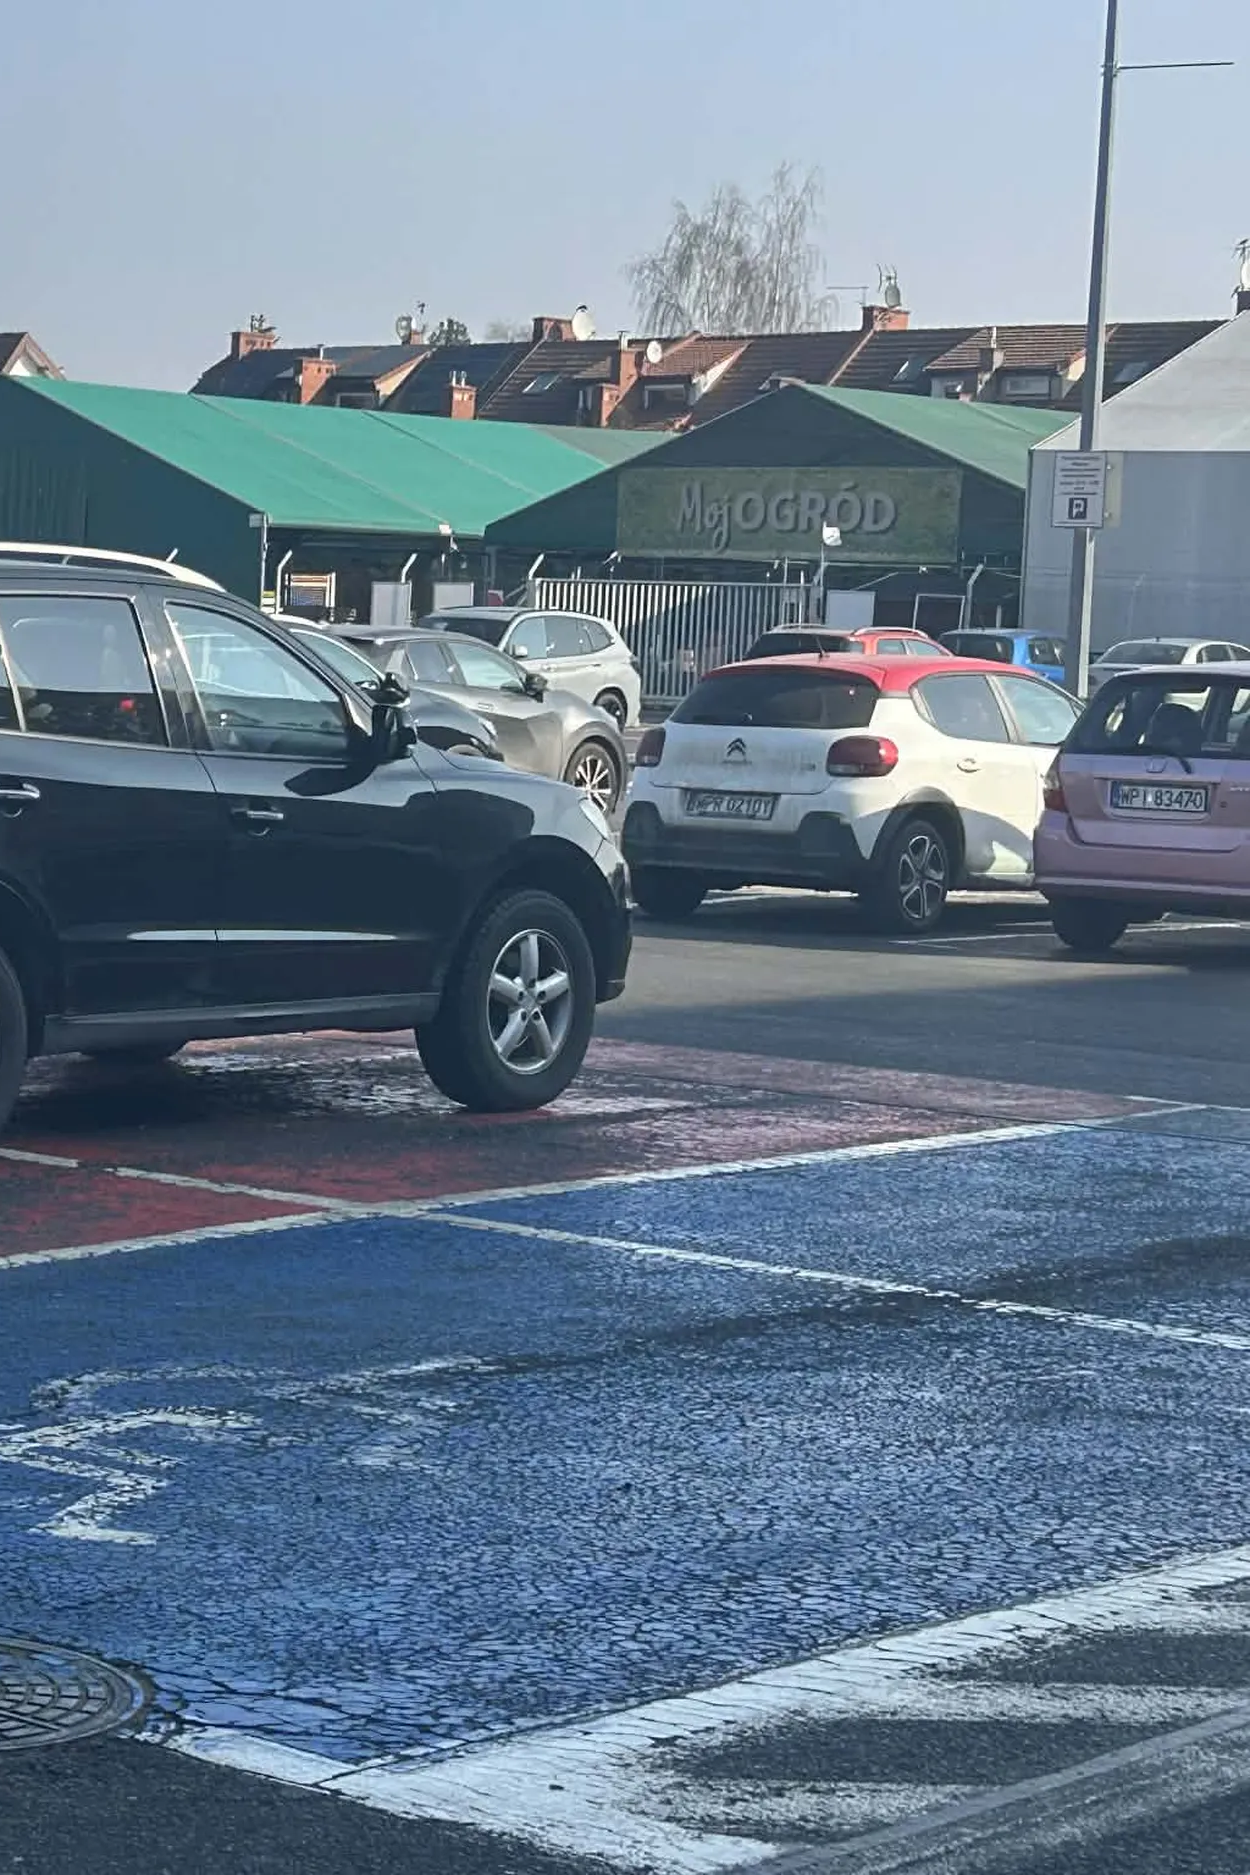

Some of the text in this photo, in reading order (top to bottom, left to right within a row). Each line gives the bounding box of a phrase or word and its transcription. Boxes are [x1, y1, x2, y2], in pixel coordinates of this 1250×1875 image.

[735, 481, 897, 533] OGRÓD
[1120, 787, 1203, 809] WPI 83470
